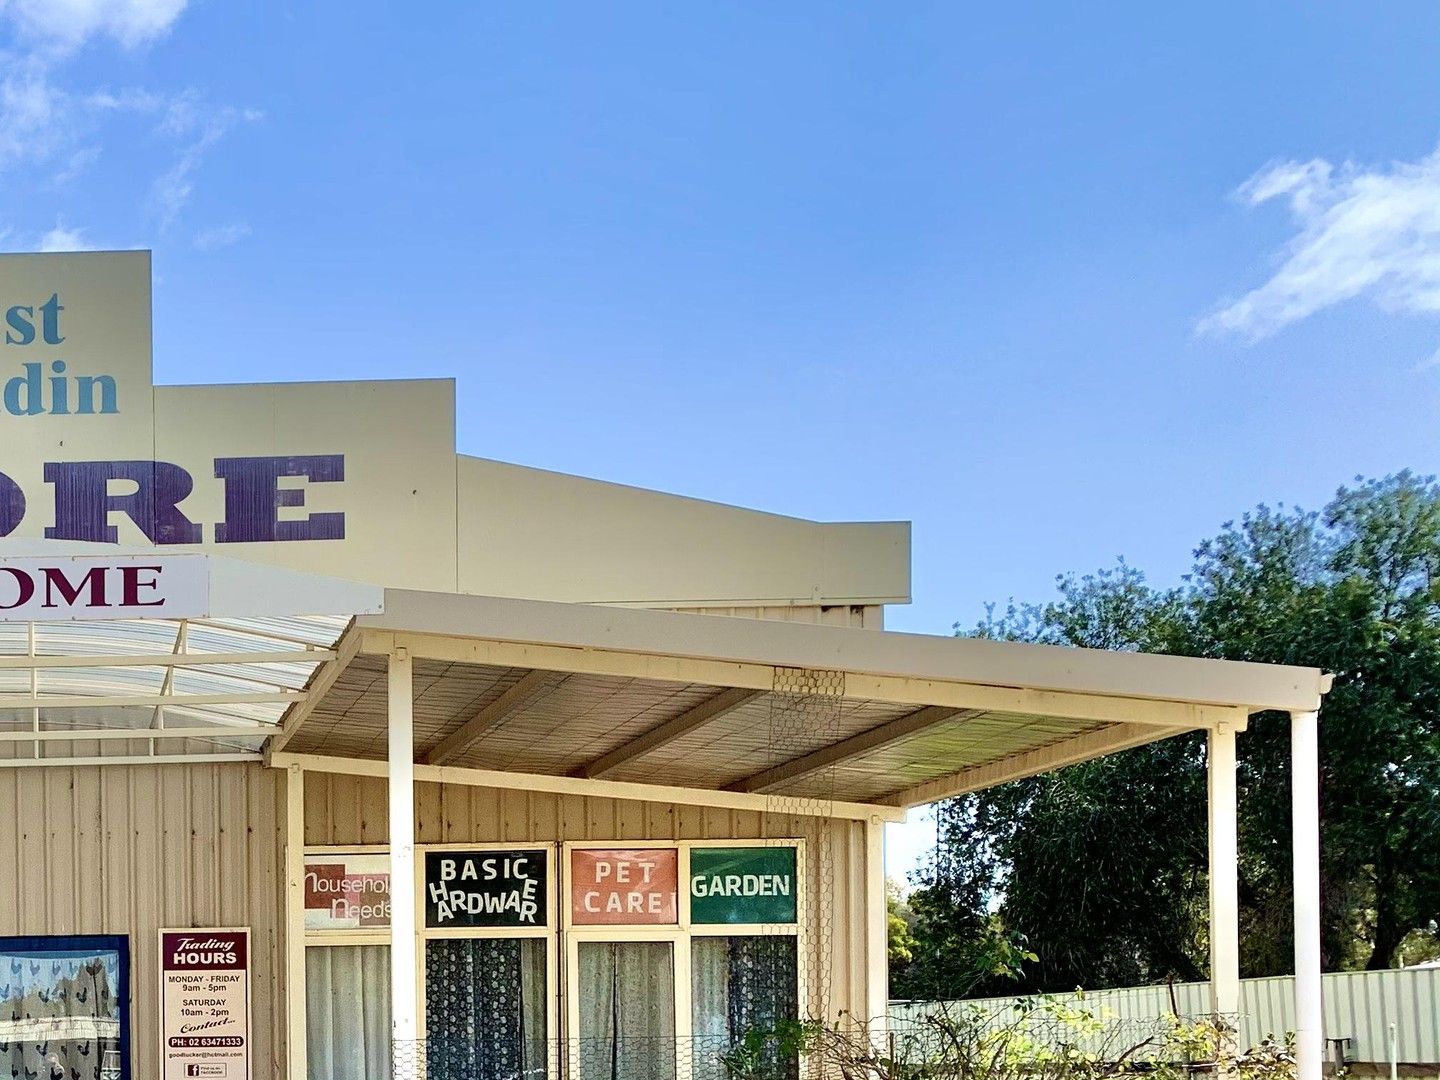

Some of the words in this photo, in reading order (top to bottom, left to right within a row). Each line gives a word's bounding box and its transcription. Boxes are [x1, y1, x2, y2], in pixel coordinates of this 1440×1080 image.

[441, 858, 528, 881] BASIC
[595, 862, 655, 883] PET
[692, 874, 790, 897] GARDEN
[429, 879, 538, 924] HARDWARE
[585, 891, 662, 913] CARE
[177, 938, 234, 952] Trading
[173, 952, 237, 964] HOURS
[169, 975, 203, 983] MONDAY
[208, 984, 227, 992] 5pm
[181, 1008, 203, 1016] 10am
[210, 1008, 229, 1017] 2pm
[171, 1038, 187, 1046] PH:
[189, 1038, 199, 1046] 02
[201, 1038, 241, 1046] 63471333
